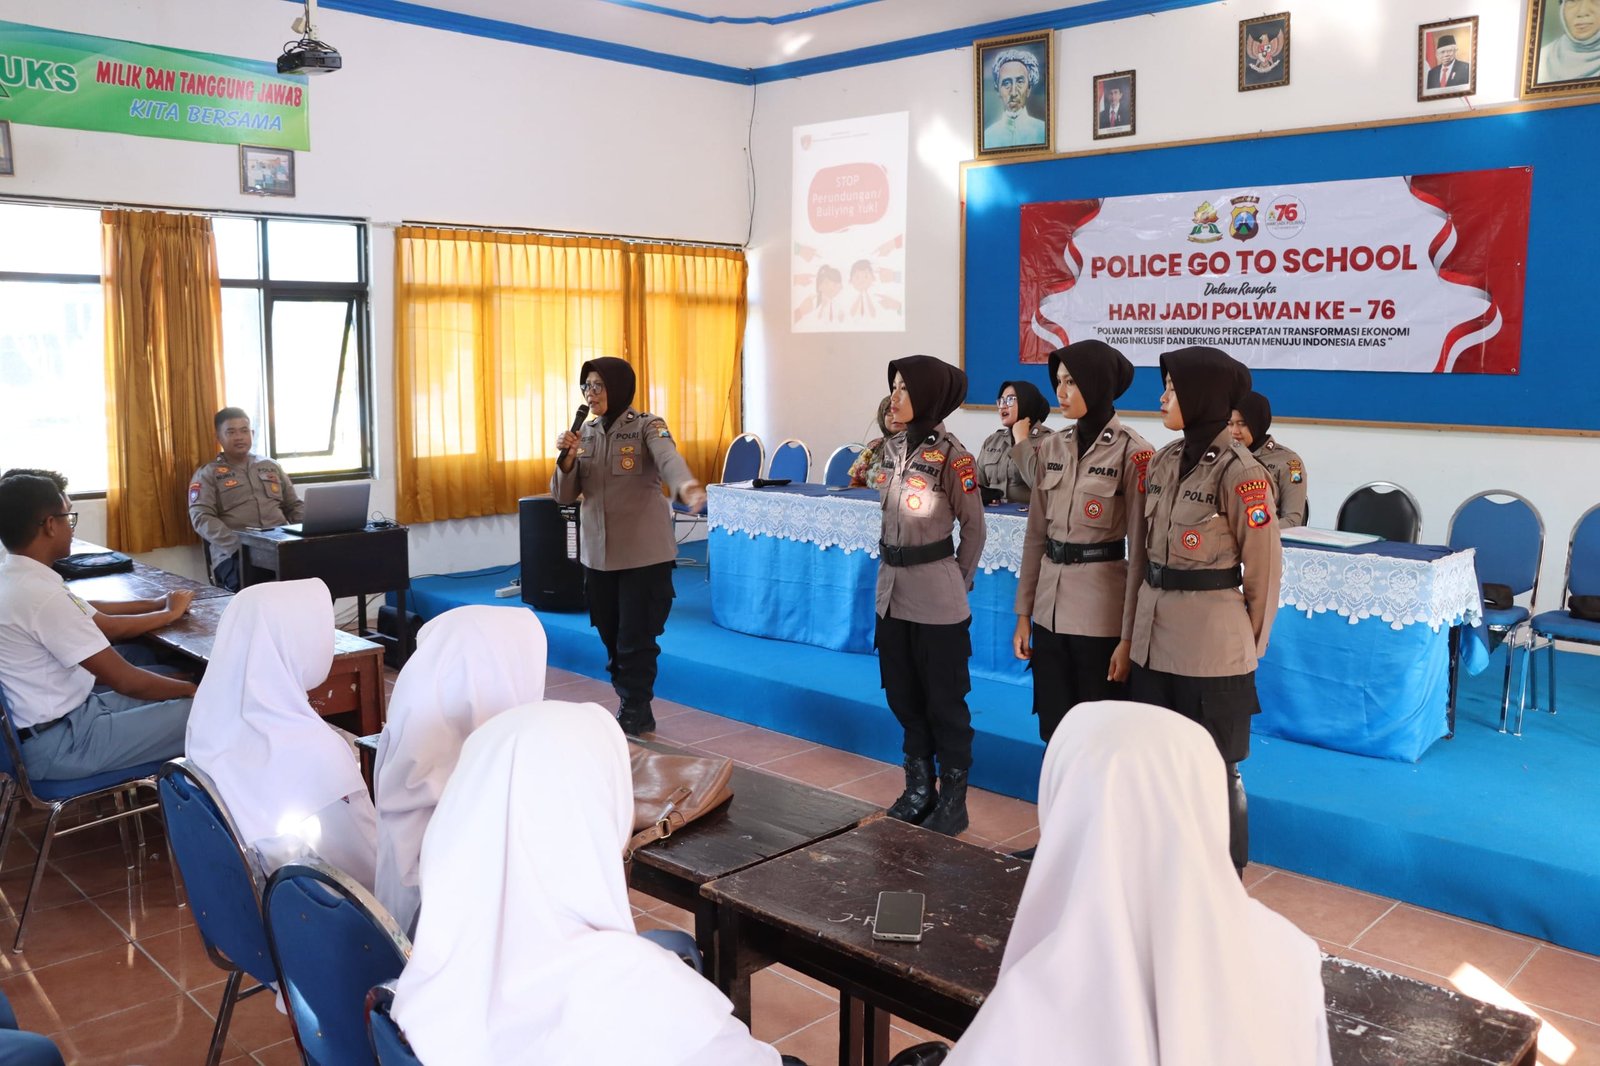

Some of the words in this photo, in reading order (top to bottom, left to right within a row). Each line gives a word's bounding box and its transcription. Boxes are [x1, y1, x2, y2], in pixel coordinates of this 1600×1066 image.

[0, 55, 78, 93] UKS
[96, 60, 142, 90] MILIK
[146, 66, 176, 93] DAN
[179, 71, 256, 102] TANGGUNG
[257, 81, 303, 108] JAWAB
[130, 99, 180, 122] KITA
[188, 105, 283, 132] BERSAMA
[835, 174, 861, 188] STOP
[1274, 203, 1298, 222] 76
[1091, 253, 1182, 279] POLICE
[1187, 251, 1231, 276] GO
[1236, 249, 1277, 275] TO
[1282, 244, 1418, 274] SCHOOL
[1203, 281, 1238, 297] Dalam
[1237, 281, 1277, 300] Rangka
[1108, 303, 1156, 321] HARI
[1159, 302, 1208, 321] JADI
[1211, 301, 1311, 320] POLWAN
[1315, 300, 1345, 320] KE
[1367, 299, 1396, 320] 76
[1133, 327, 1164, 335] PRESISI
[1164, 326, 1221, 336] MENDUKUNG
[1221, 327, 1282, 336] PERCEPATAN
[1282, 327, 1360, 336] TRANSFORMASI
[1361, 327, 1410, 336] EKONOMI
[1105, 336, 1129, 345] YANG
[1129, 337, 1166, 345] INKLUSIF
[1166, 337, 1186, 345] DAN
[1186, 337, 1261, 346] BERKELANJUTAN
[1261, 337, 1302, 346] MENUJU
[1302, 337, 1356, 347] INDONESIA
[616, 431, 639, 441] POLRI
[909, 461, 941, 478] POLRI
[1088, 466, 1119, 478] POLRI
[1182, 490, 1219, 506] POLRI
